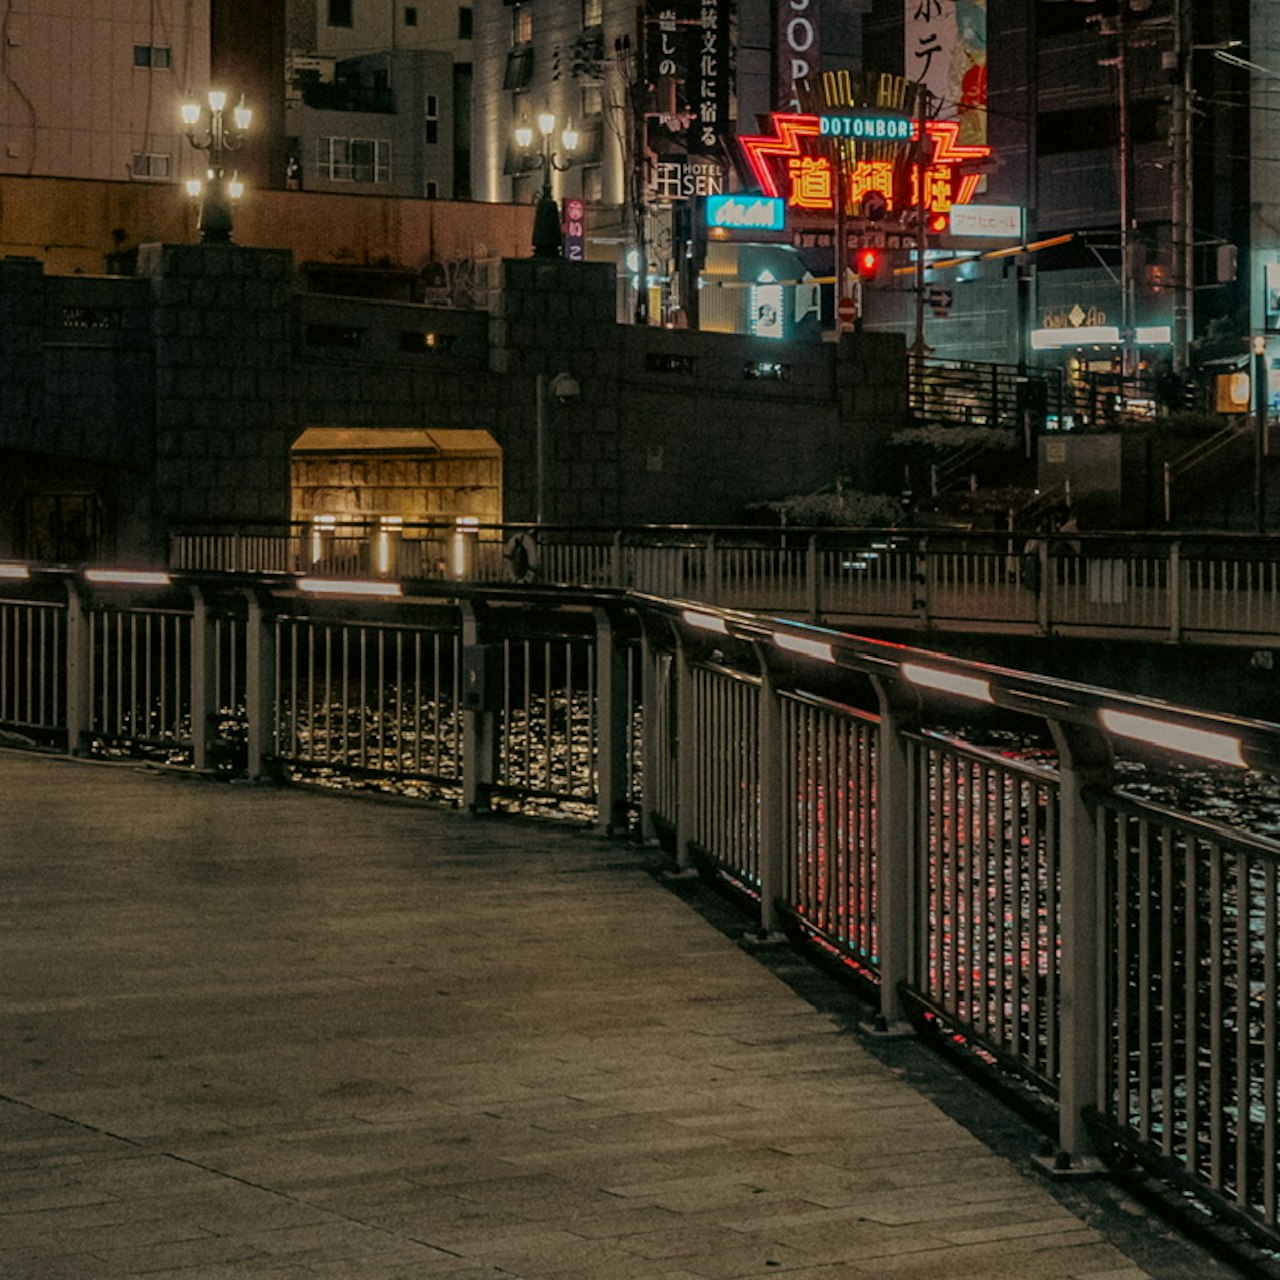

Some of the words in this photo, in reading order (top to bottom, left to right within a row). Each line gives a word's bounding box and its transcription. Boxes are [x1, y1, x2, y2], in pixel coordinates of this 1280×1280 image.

[682, 163, 723, 177] HOTEL
[682, 176, 724, 197] SEN
[788, 156, 953, 214] 道頓堀
